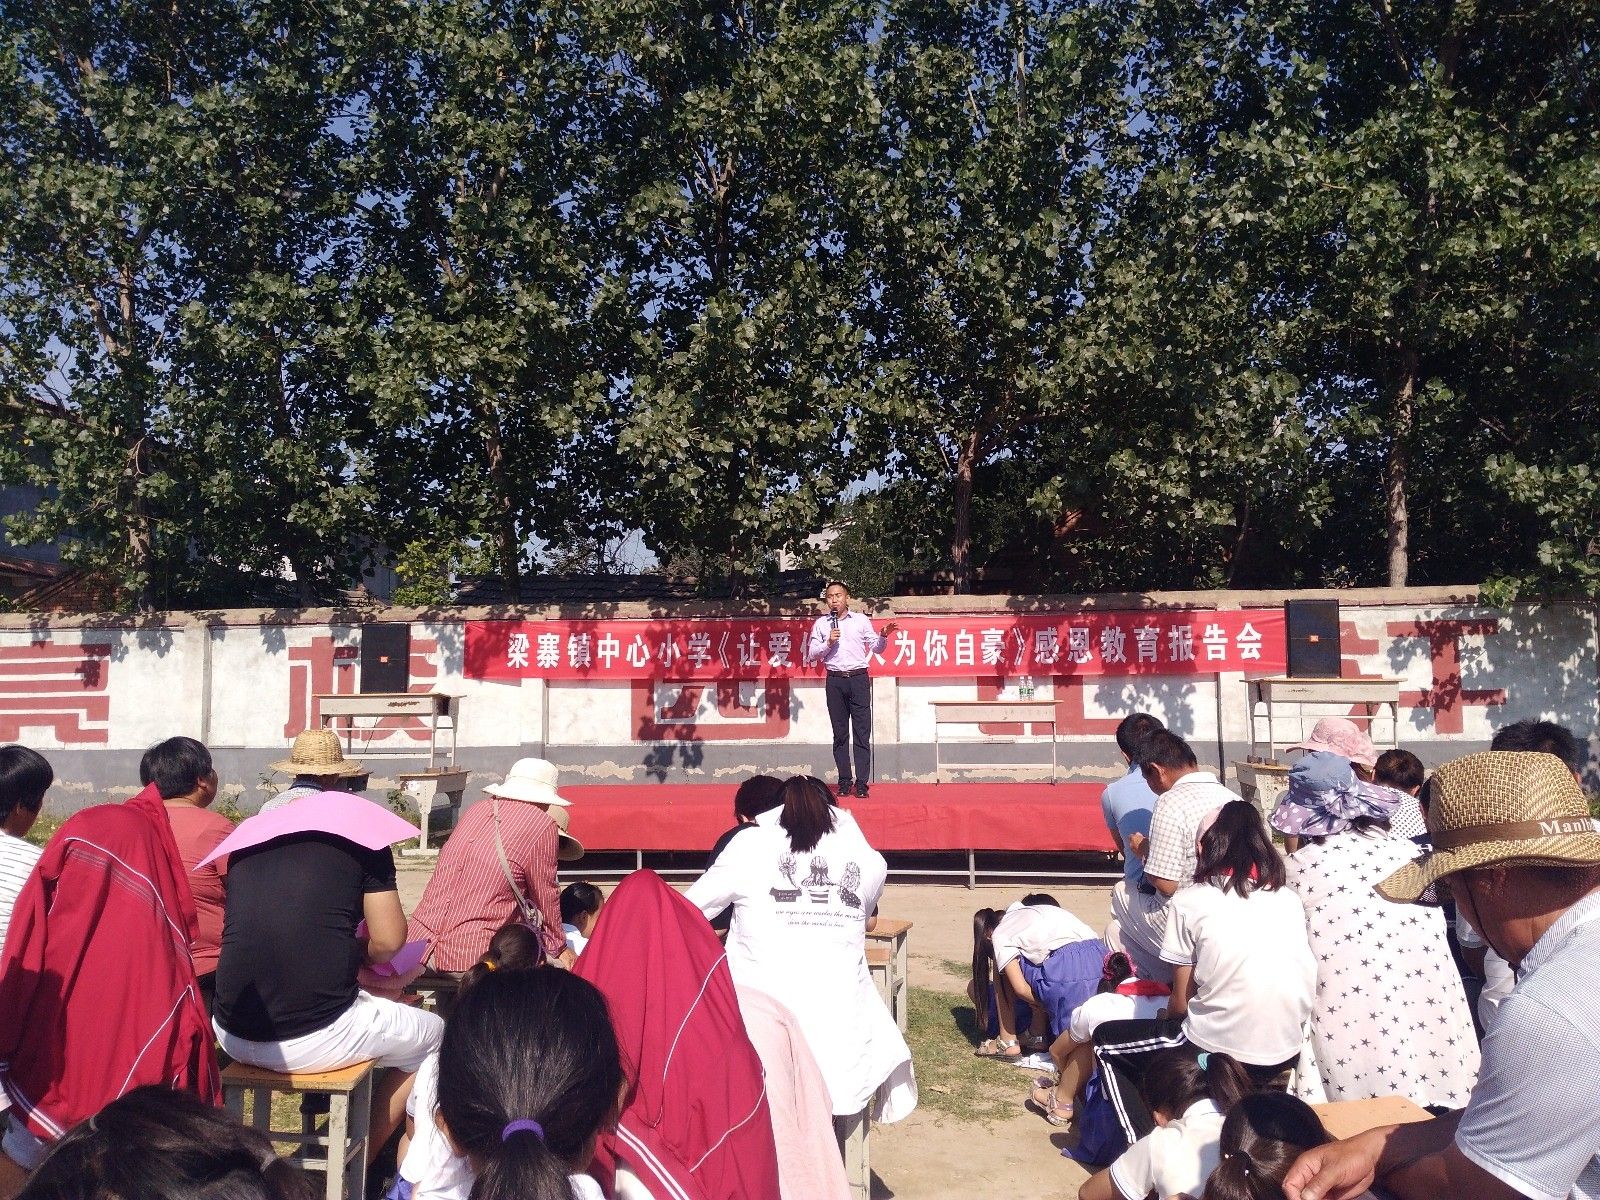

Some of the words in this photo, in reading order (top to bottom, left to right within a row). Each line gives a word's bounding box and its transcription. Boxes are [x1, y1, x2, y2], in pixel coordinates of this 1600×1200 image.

[506, 622, 1263, 670] 梁寨镇中心小学《让爱为你自豪》感恩教育报告会
